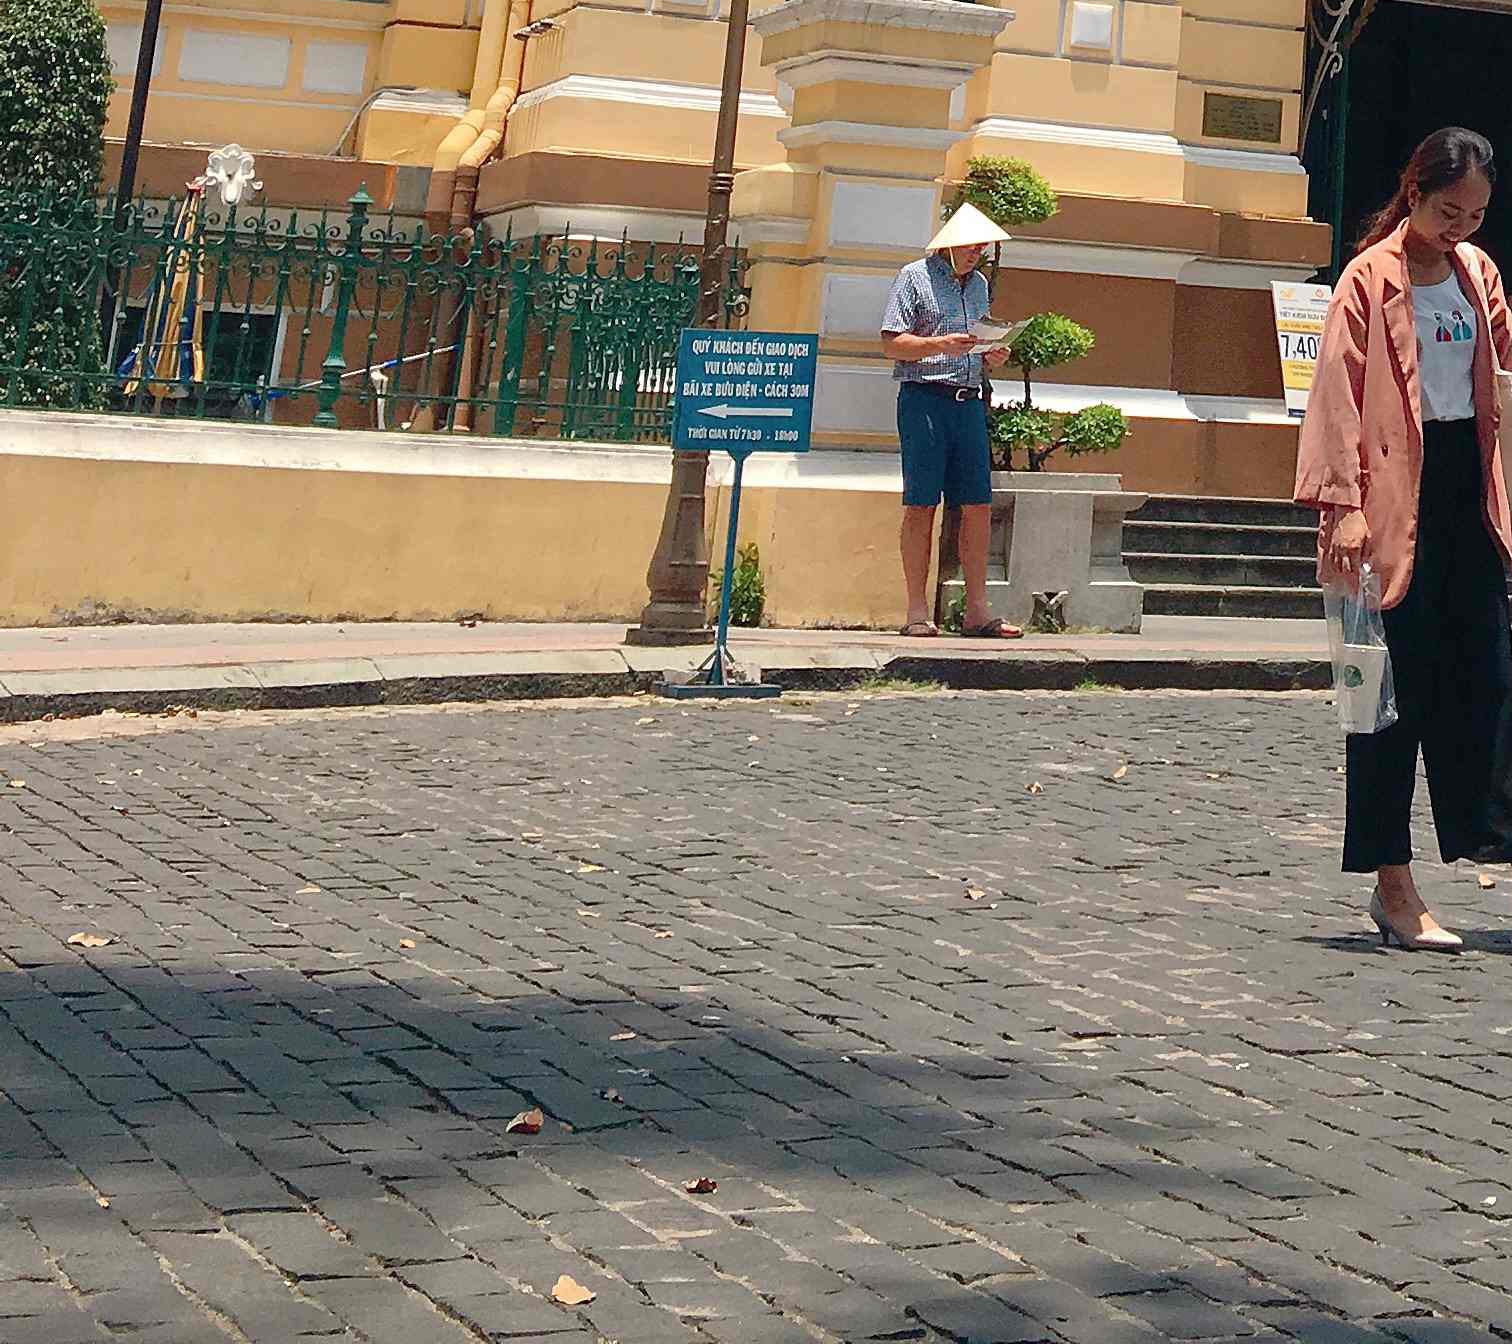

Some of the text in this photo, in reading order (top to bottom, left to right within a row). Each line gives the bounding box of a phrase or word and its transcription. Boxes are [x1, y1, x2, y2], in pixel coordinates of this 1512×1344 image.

[692, 336, 809, 359] QUÝ KHÁCH ĐẾN GIAO DỊCH
[705, 361, 720, 375] VUI
[722, 358, 746, 376] LÒNG
[764, 362, 776, 376] XE
[778, 362, 793, 379] TẠI
[683, 379, 700, 396] BÃI
[700, 383, 713, 396] XE
[764, 381, 788, 397] CÁCH
[790, 384, 809, 398] 30M
[708, 428, 728, 440] GIAN
